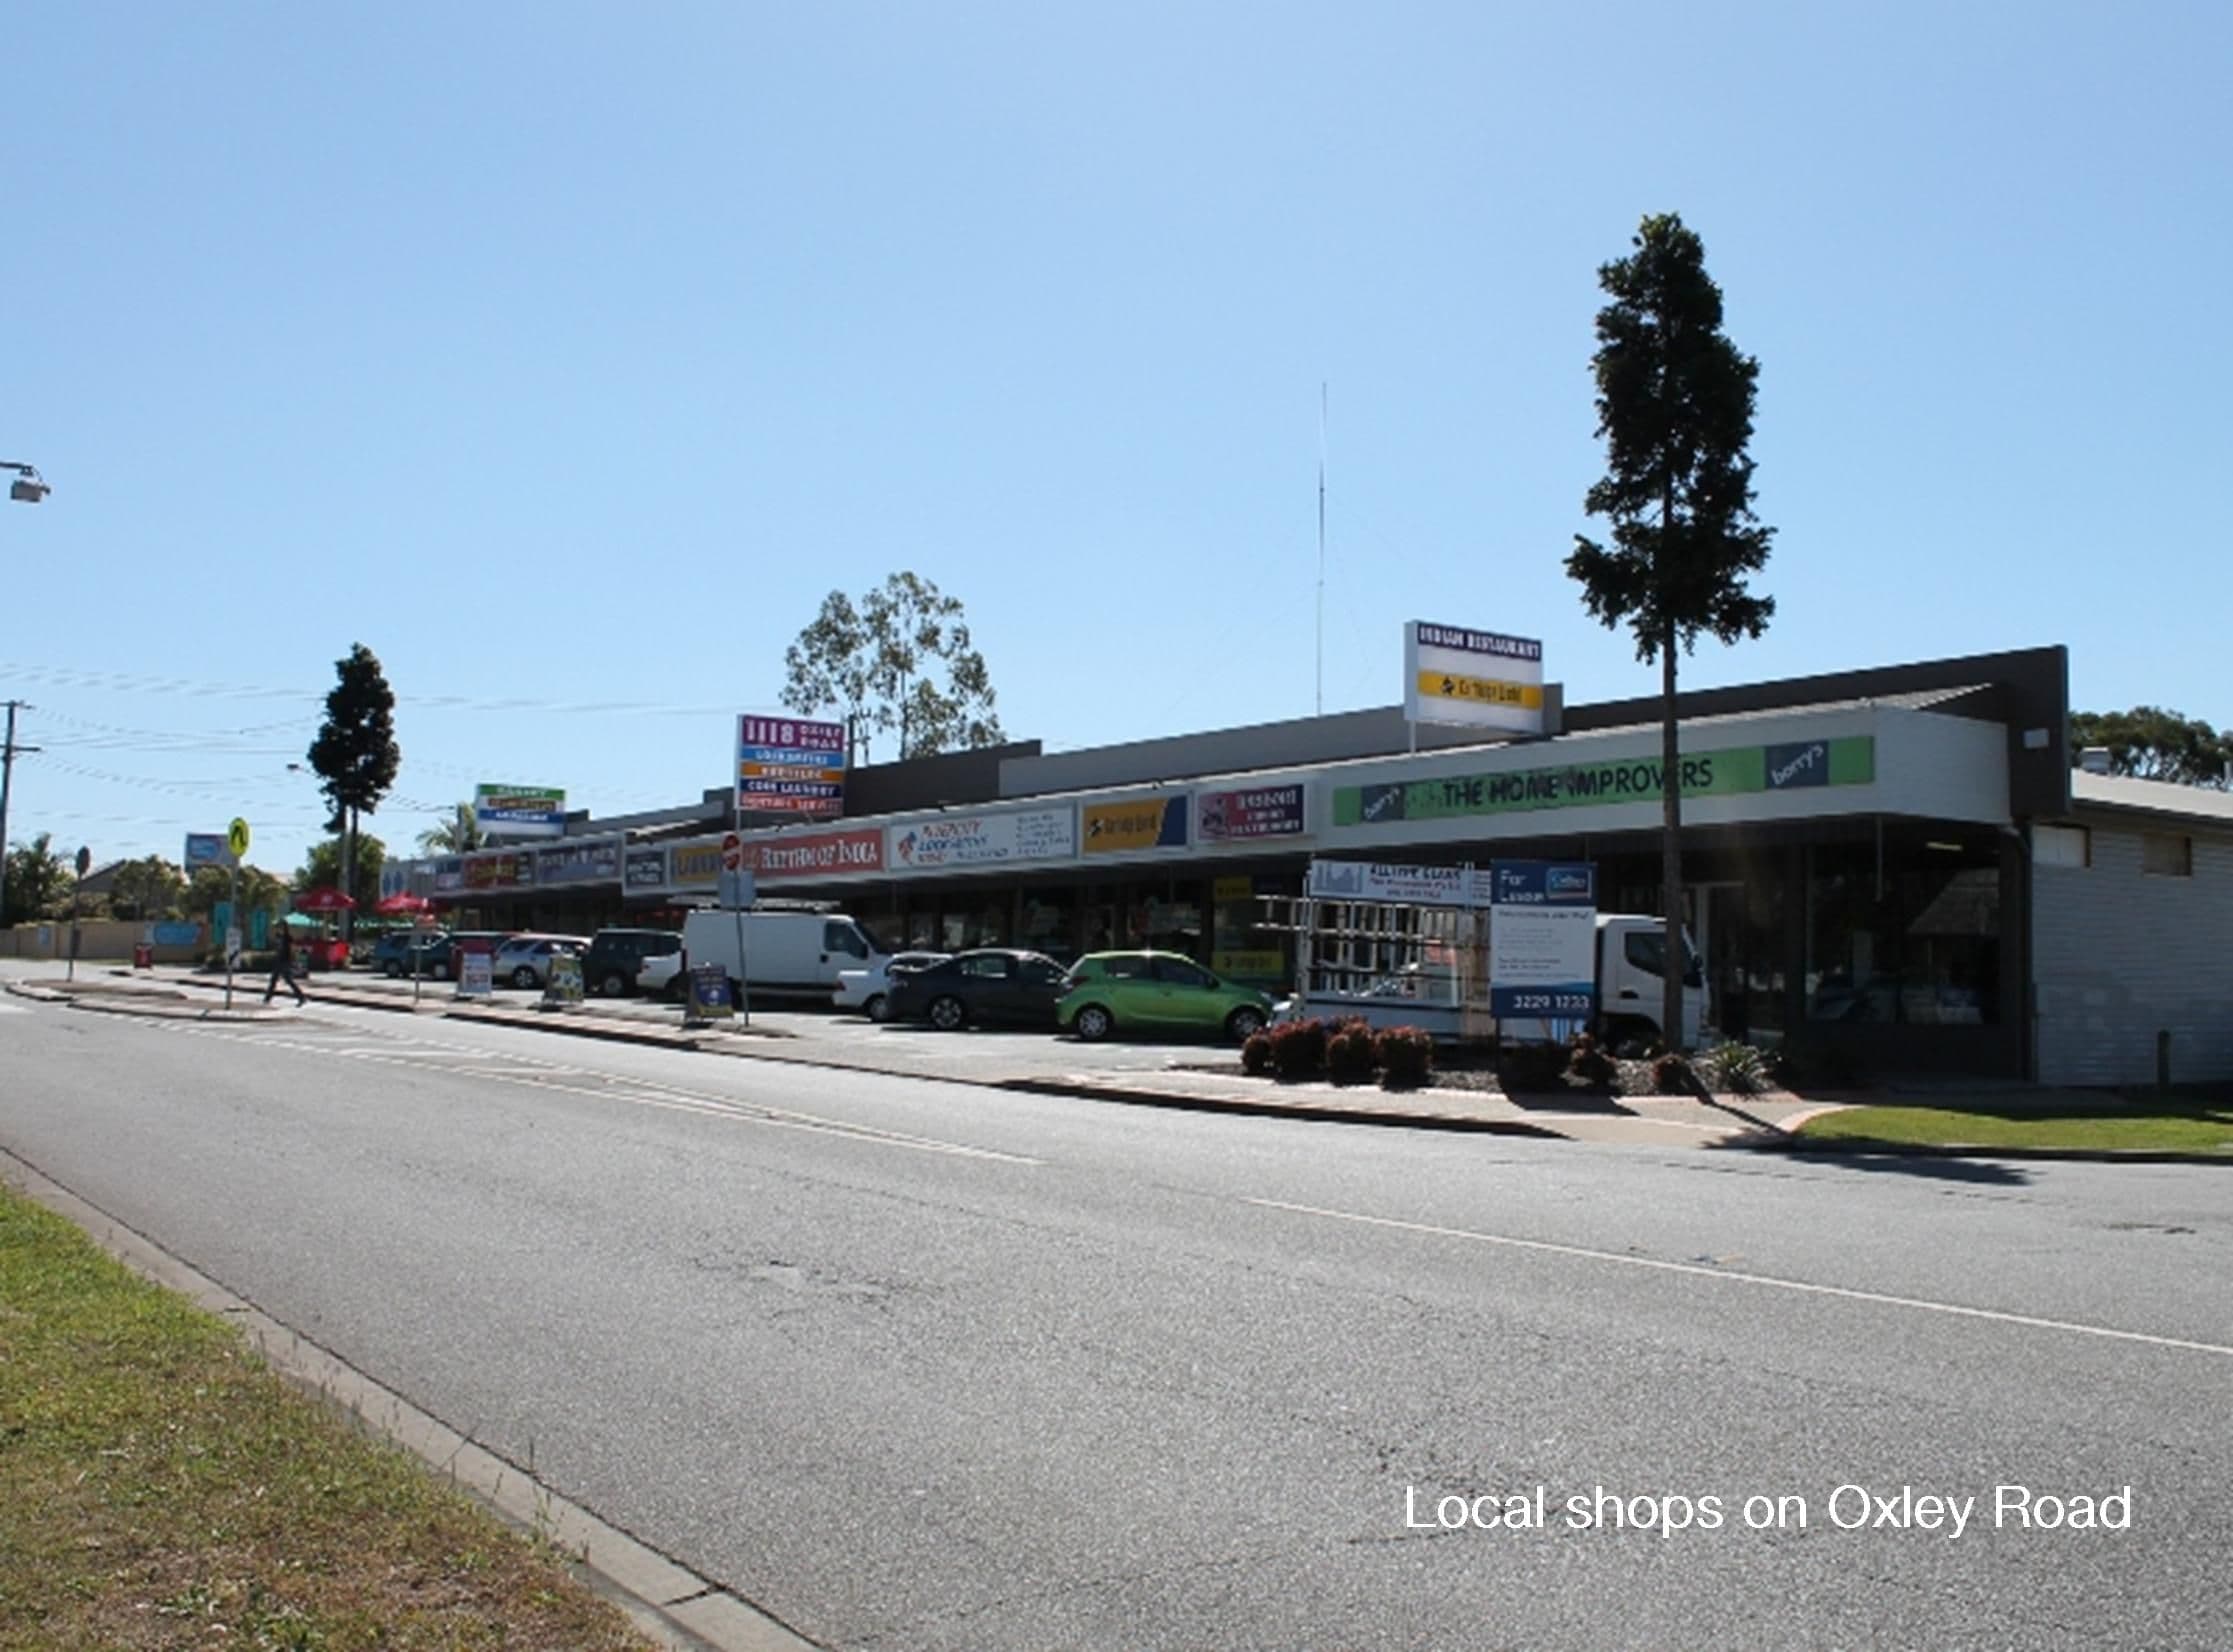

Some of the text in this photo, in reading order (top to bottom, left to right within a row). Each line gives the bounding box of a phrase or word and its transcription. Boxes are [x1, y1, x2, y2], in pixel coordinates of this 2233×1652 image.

[745, 718, 795, 744] 1118
[1443, 759, 1714, 808] THE HOME IMPROVRS
[1501, 870, 1527, 886] For
